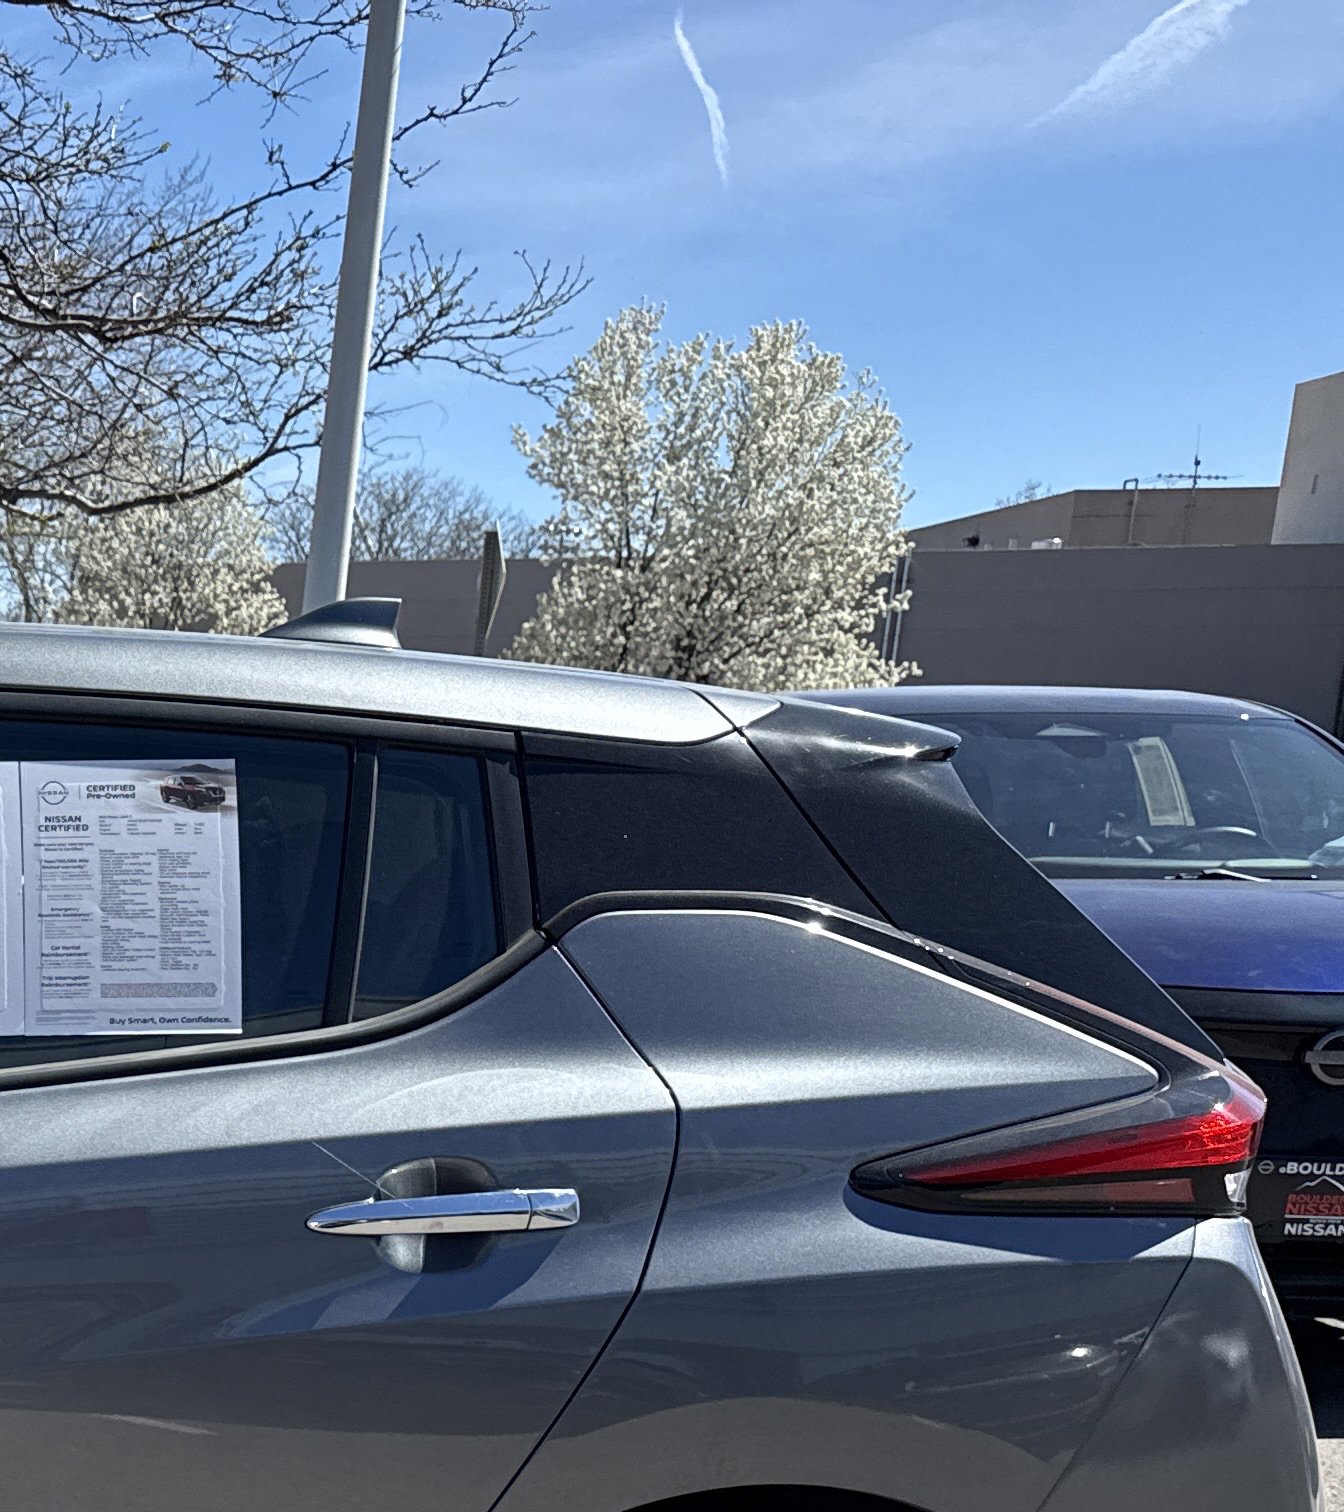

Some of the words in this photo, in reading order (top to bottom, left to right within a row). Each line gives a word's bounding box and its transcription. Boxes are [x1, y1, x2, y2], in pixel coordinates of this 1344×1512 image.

[86, 784, 136, 792] CERTIFIED
[86, 792, 136, 800] Pre-Owned
[44, 815, 82, 823] NISSAN
[37, 823, 89, 833] CERTIFIED
[109, 1017, 127, 1026] Buy
[127, 1016, 158, 1025] Smart,
[158, 1016, 180, 1024] Own
[180, 1015, 233, 1024] Confidence.
